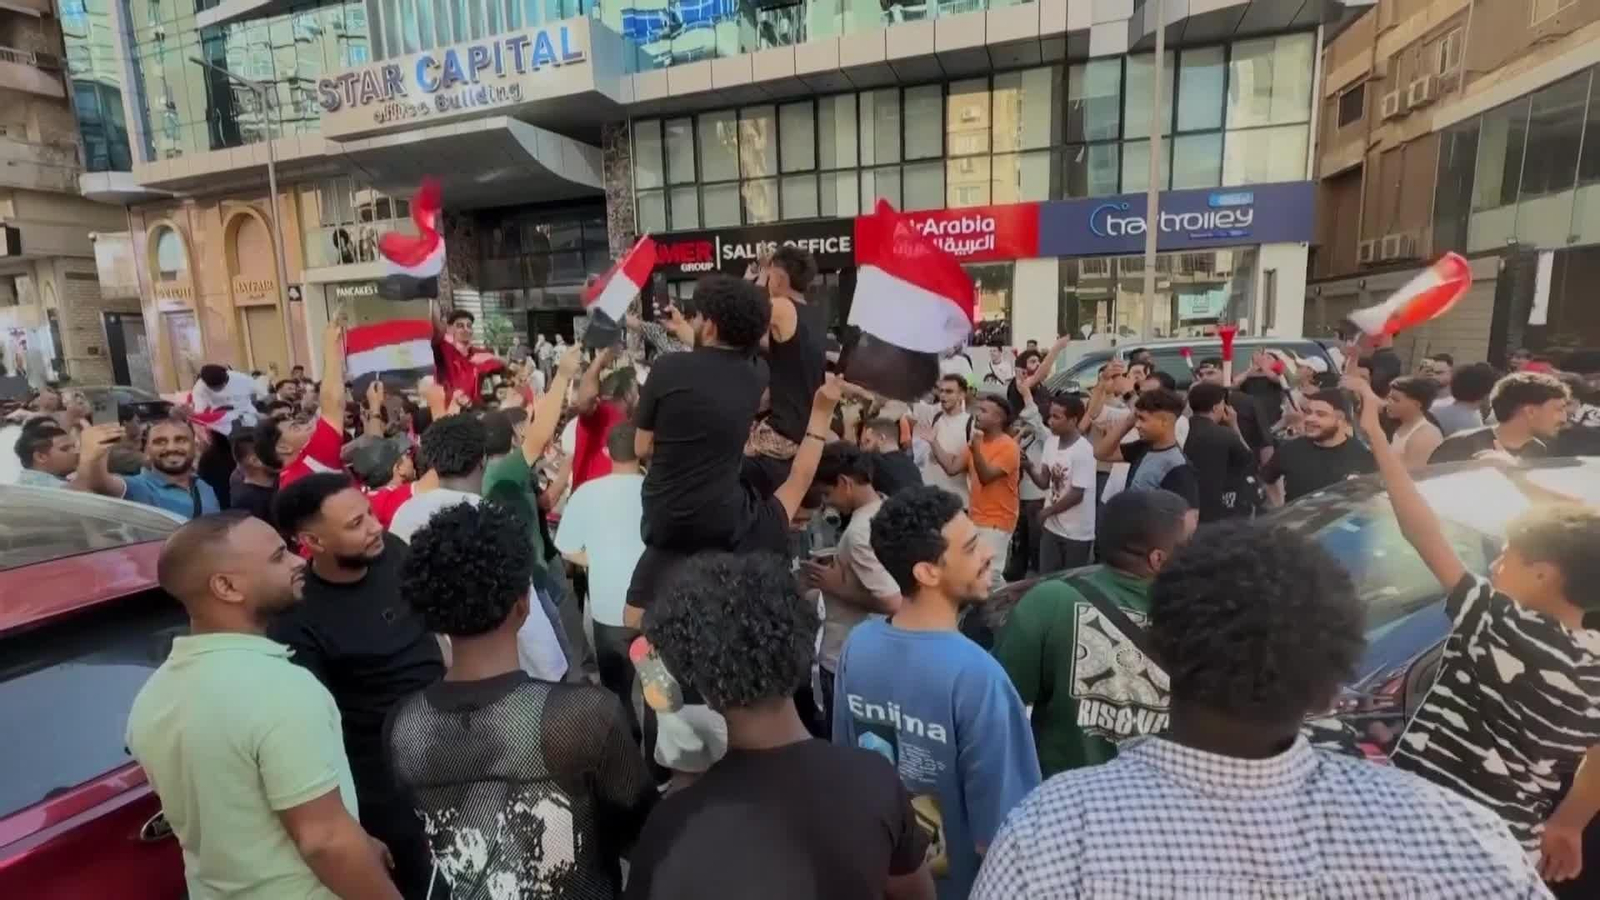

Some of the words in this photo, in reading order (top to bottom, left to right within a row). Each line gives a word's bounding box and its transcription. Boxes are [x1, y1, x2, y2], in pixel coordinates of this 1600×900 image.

[317, 63, 409, 113] STAR
[416, 26, 586, 94] CAPITAL
[943, 233, 996, 257] العربية
[680, 262, 715, 273] GROUP
[335, 285, 374, 297] PANCAKES
